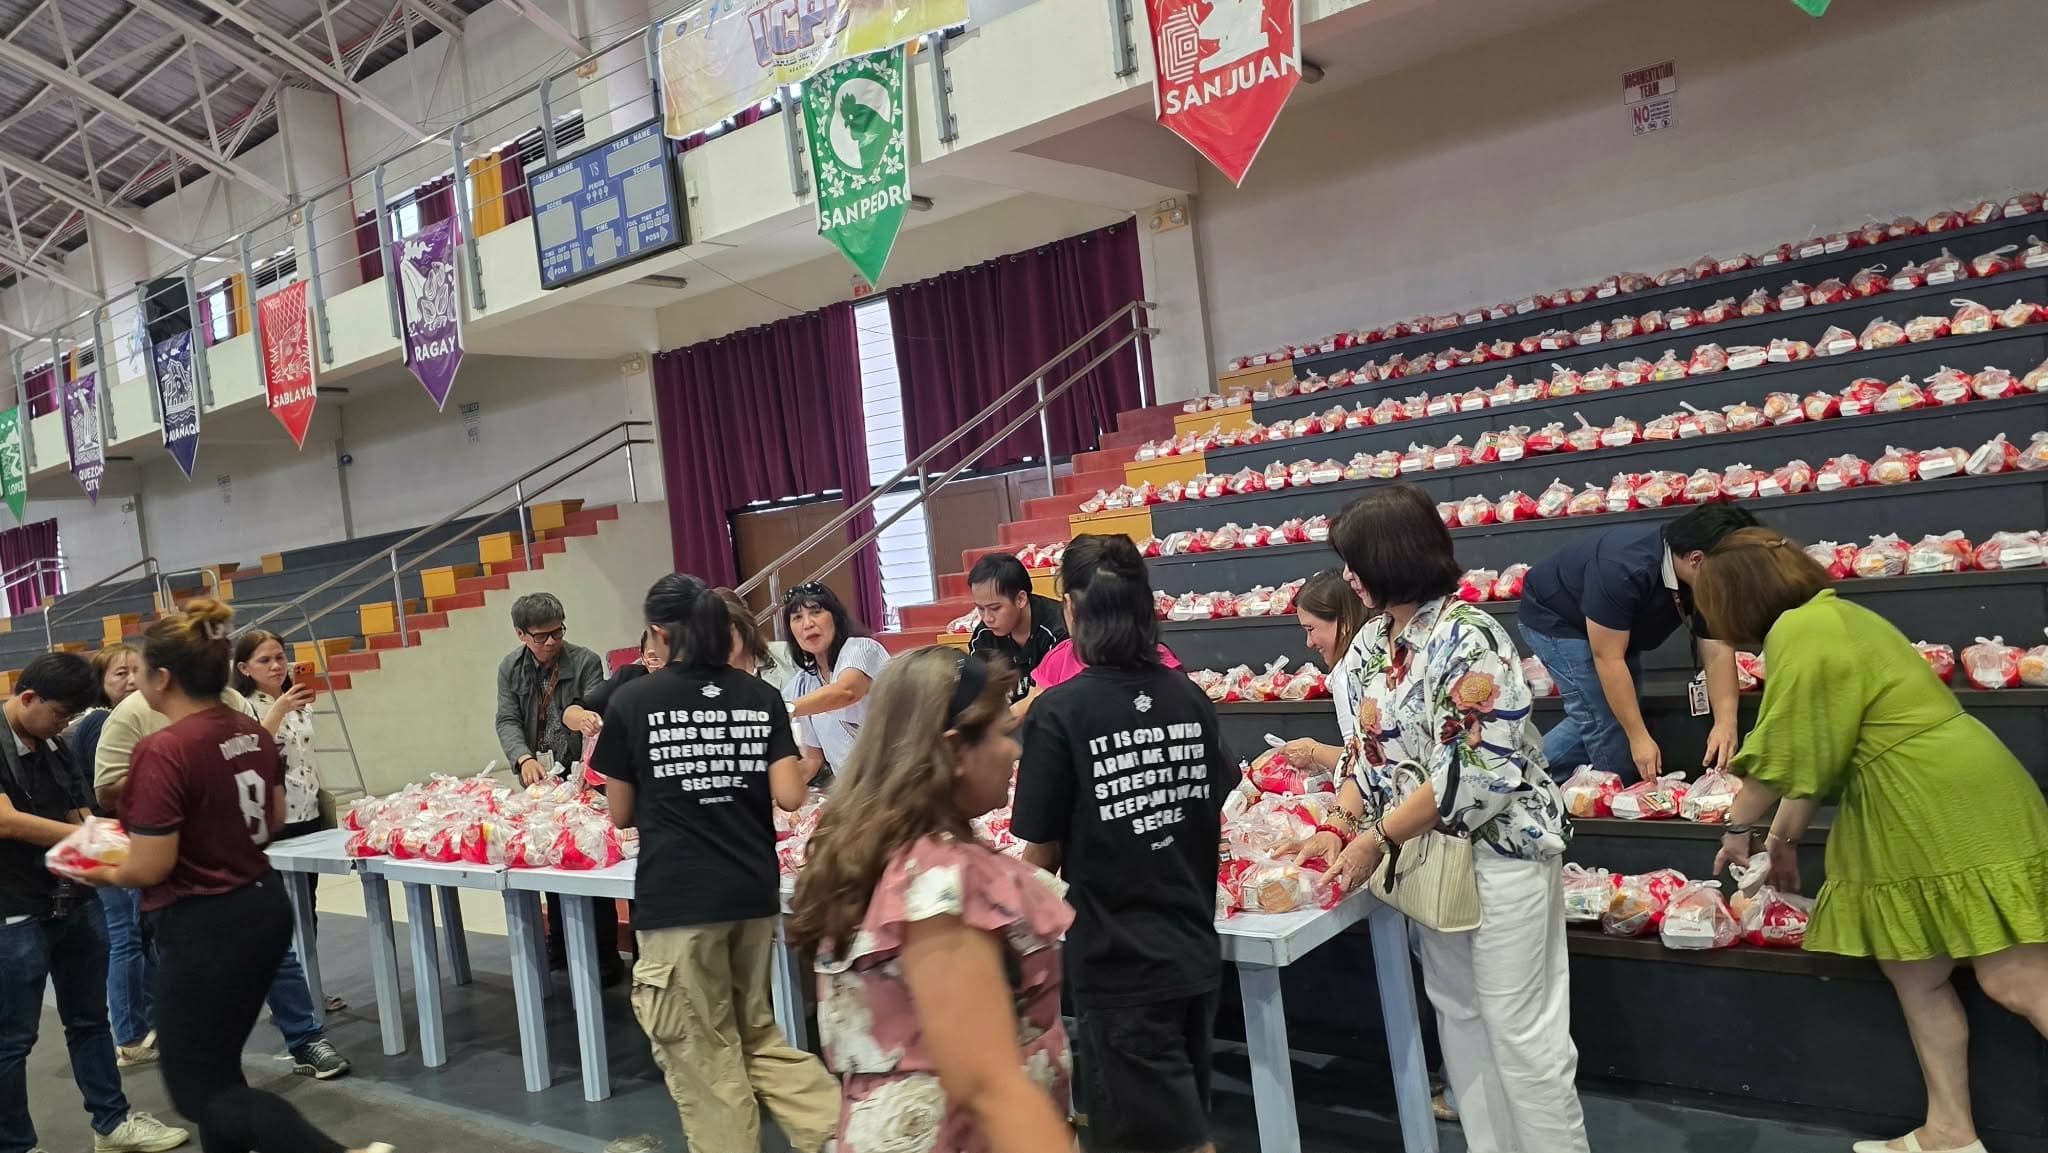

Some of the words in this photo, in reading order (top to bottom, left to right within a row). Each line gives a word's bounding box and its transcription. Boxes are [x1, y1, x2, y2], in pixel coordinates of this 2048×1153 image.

[1166, 75, 1222, 115] SAN
[1227, 52, 1300, 96] JUAN
[1640, 81, 1660, 99] TEAM
[1633, 105, 1650, 125] NO
[612, 137, 629, 151] TEAM
[633, 128, 651, 141] NAME
[538, 169, 554, 183] TEAM
[557, 162, 574, 174] NAME
[588, 161, 600, 177] VS
[633, 163, 651, 176] SCORE
[588, 180, 605, 191] PERIOD
[821, 202, 858, 231] SAN
[596, 222, 609, 233] TIME
[645, 232, 660, 243] POSS
[554, 265, 567, 275] POSS
[414, 335, 456, 363] RAGAY
[79, 463, 104, 480] QUEZON
[85, 478, 100, 491] CITY
[648, 711, 665, 726] IT
[669, 710, 689, 723] IS
[692, 710, 727, 723] GOD
[731, 709, 770, 722] WHO
[648, 726, 698, 744] ARMS
[700, 727, 726, 740] ME
[1089, 736, 1108, 755] IT
[1113, 730, 1132, 749] IS
[1167, 722, 1202, 740] WHO
[649, 743, 735, 761] STRENGTH
[653, 760, 708, 779] KEEPS
[710, 760, 735, 772] MY
[738, 760, 768, 772] WA
[681, 776, 749, 791] SECURE.
[234, 769, 269, 845] 8
